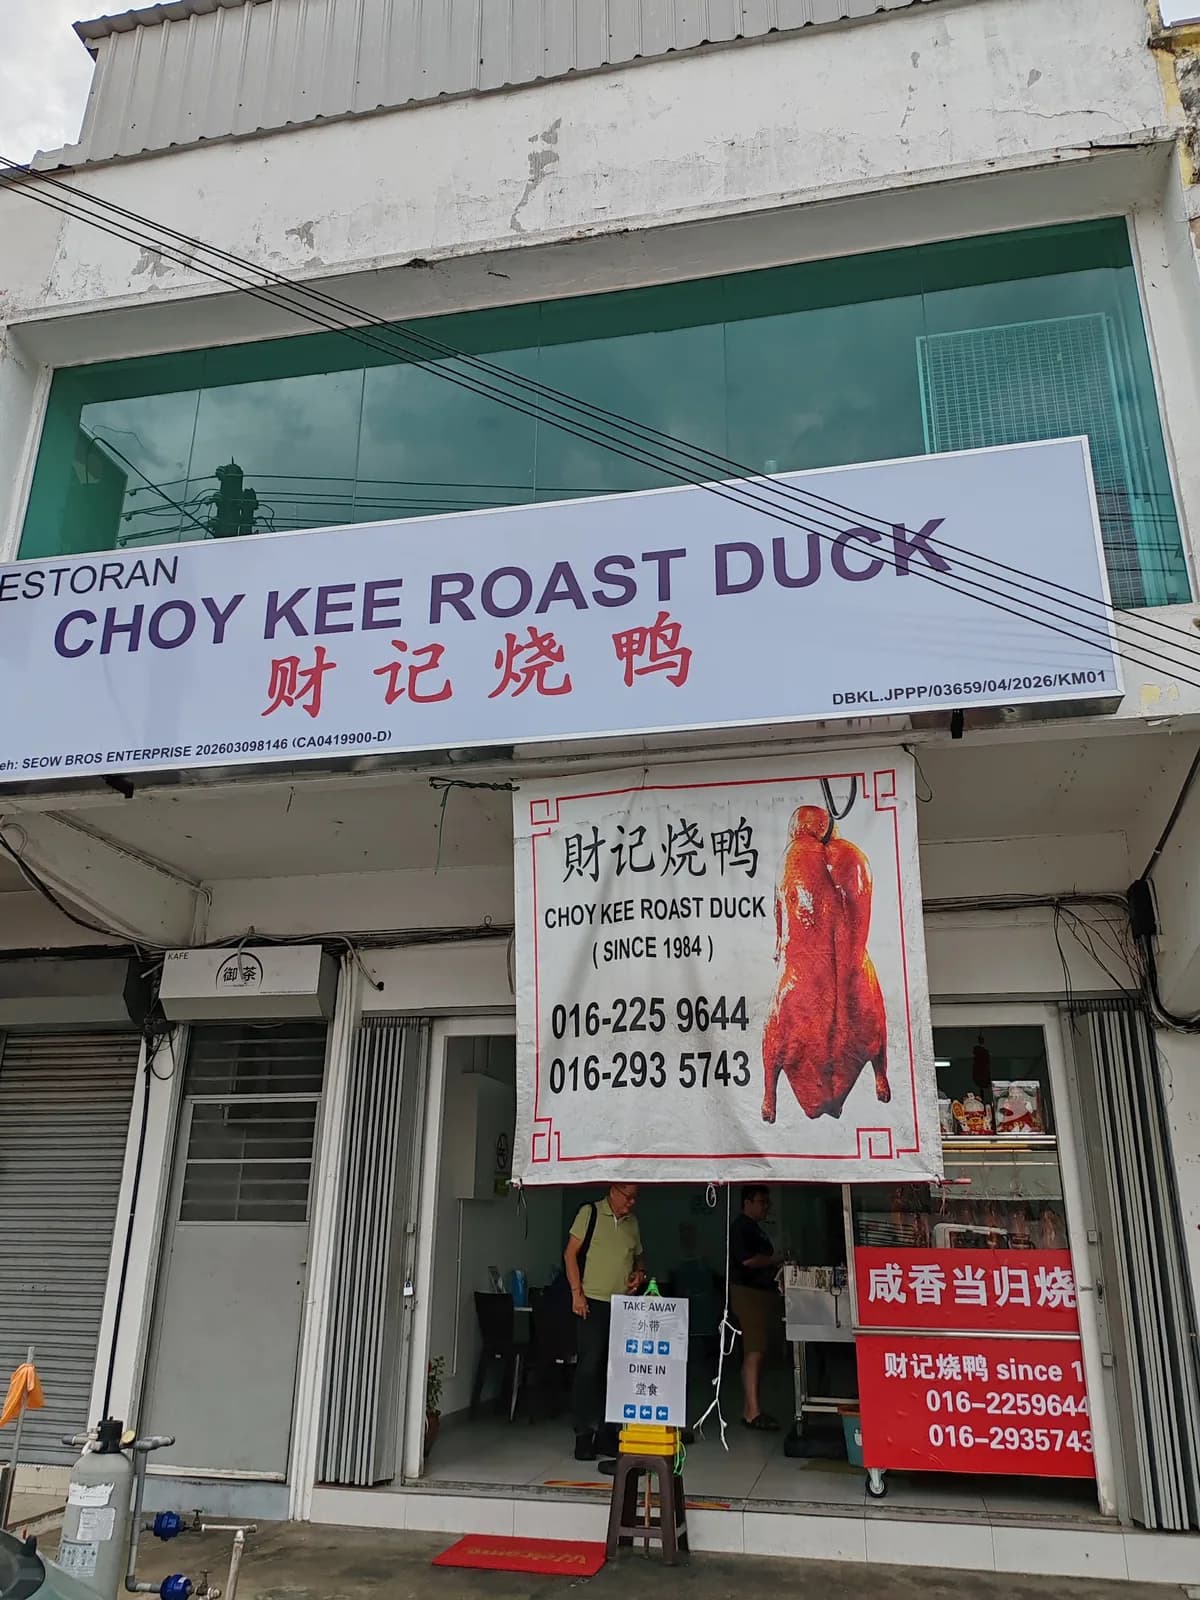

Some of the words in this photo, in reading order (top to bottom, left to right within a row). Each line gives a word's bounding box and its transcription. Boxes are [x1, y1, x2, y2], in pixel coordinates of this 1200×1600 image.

[54, 594, 246, 659] CHOY
[264, 579, 403, 639] KEE
[429, 548, 687, 624] ROAST
[714, 517, 952, 596] DUCK
[261, 611, 693, 718] 财记烧鸭
[832, 669, 1106, 705] DBKL.JPPP/03659/04/2026/KM01
[22, 755, 62, 769] SEOW
[65, 752, 103, 766] BROS
[106, 745, 192, 762] ENTERPRISE
[196, 738, 288, 755] 202603098146
[292, 730, 392, 748] (CA0419900-D)
[545, 903, 597, 929] CHOY
[600, 899, 634, 925] KEE
[640, 896, 704, 920] ROAST
[710, 896, 767, 918] DUCK
[167, 952, 189, 961] KAFE
[551, 997, 666, 1040] 016-225
[676, 996, 750, 1033] 9644
[549, 1052, 667, 1094] 016-293
[679, 1050, 751, 1088] 5743
[868, 1263, 1077, 1308] 咸香当归烧
[623, 1301, 646, 1311] TAKE
[648, 1302, 677, 1313] AWAY
[629, 1363, 653, 1374] DINE
[655, 1365, 666, 1375] IN
[884, 1352, 989, 1382] 财记烧鸭
[996, 1358, 1062, 1382] since
[635, 1382, 658, 1396] 堂食
